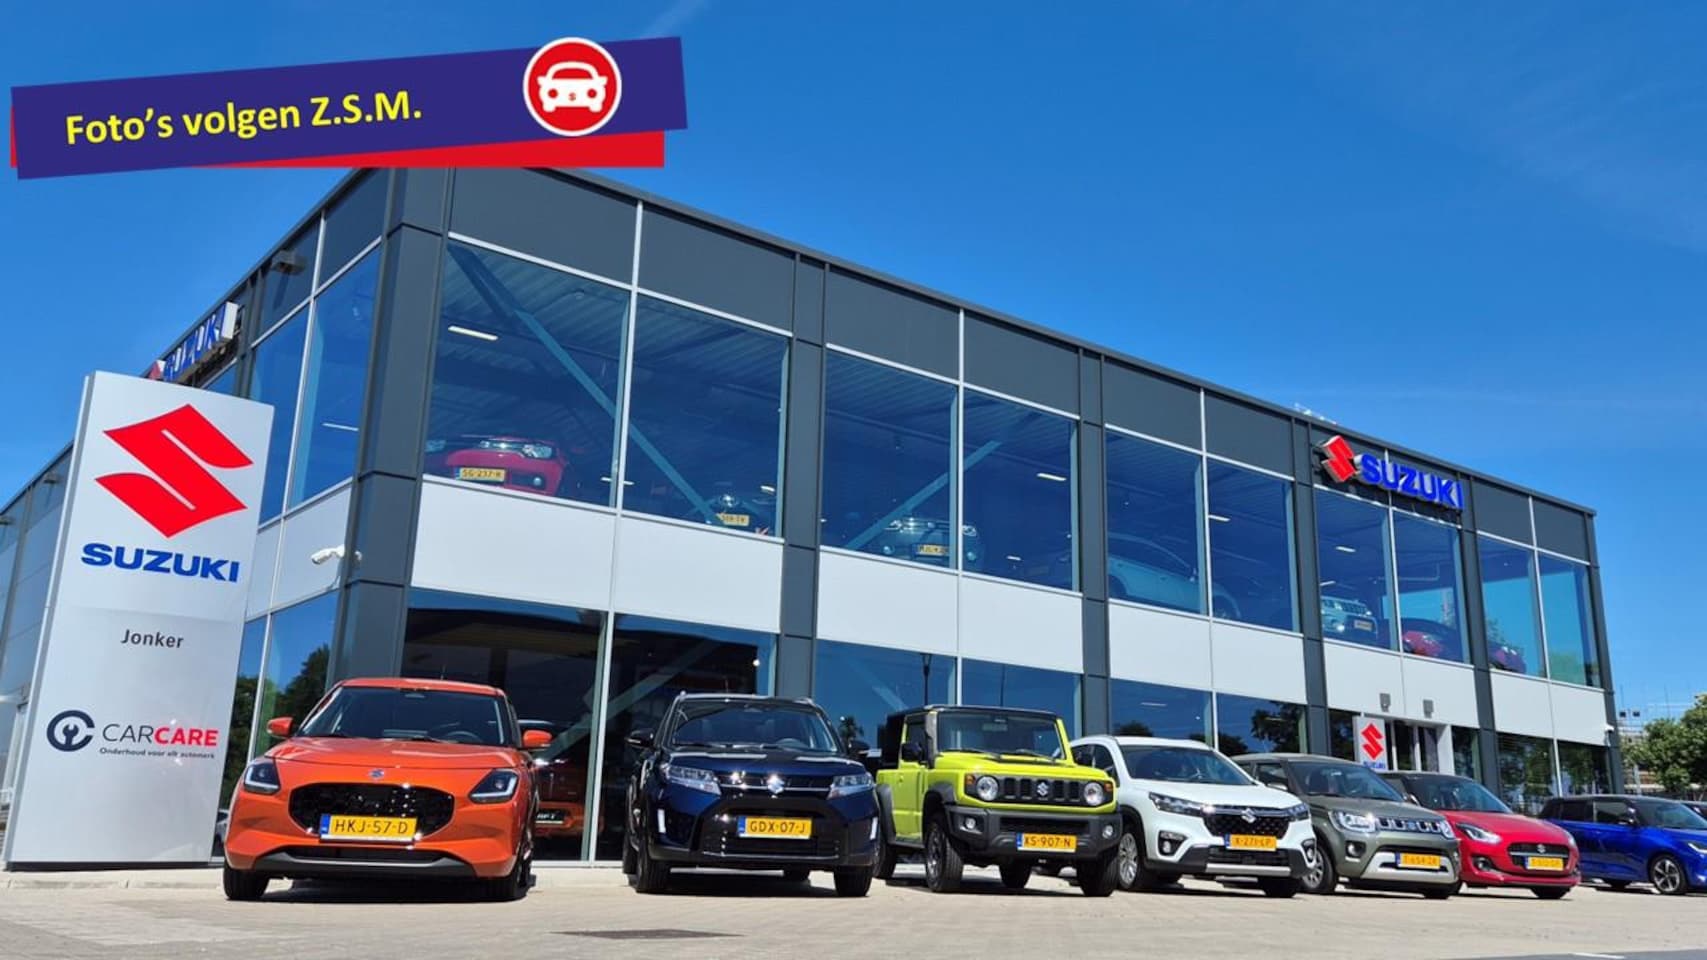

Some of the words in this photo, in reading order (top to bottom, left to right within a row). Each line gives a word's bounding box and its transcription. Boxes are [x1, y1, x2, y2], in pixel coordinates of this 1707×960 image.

[1355, 453, 1465, 511] SUZUKI
[81, 543, 241, 582] SUZUKI
[120, 629, 184, 648] Jonker
[102, 723, 219, 747] CARCARE
[99, 747, 146, 756] Onderhoud
[180, 751, 215, 759] automerk
[334, 818, 409, 834] HKJ-57-D
[750, 820, 805, 833] GDX-07-J
[1024, 836, 1071, 848] XS-907-N
